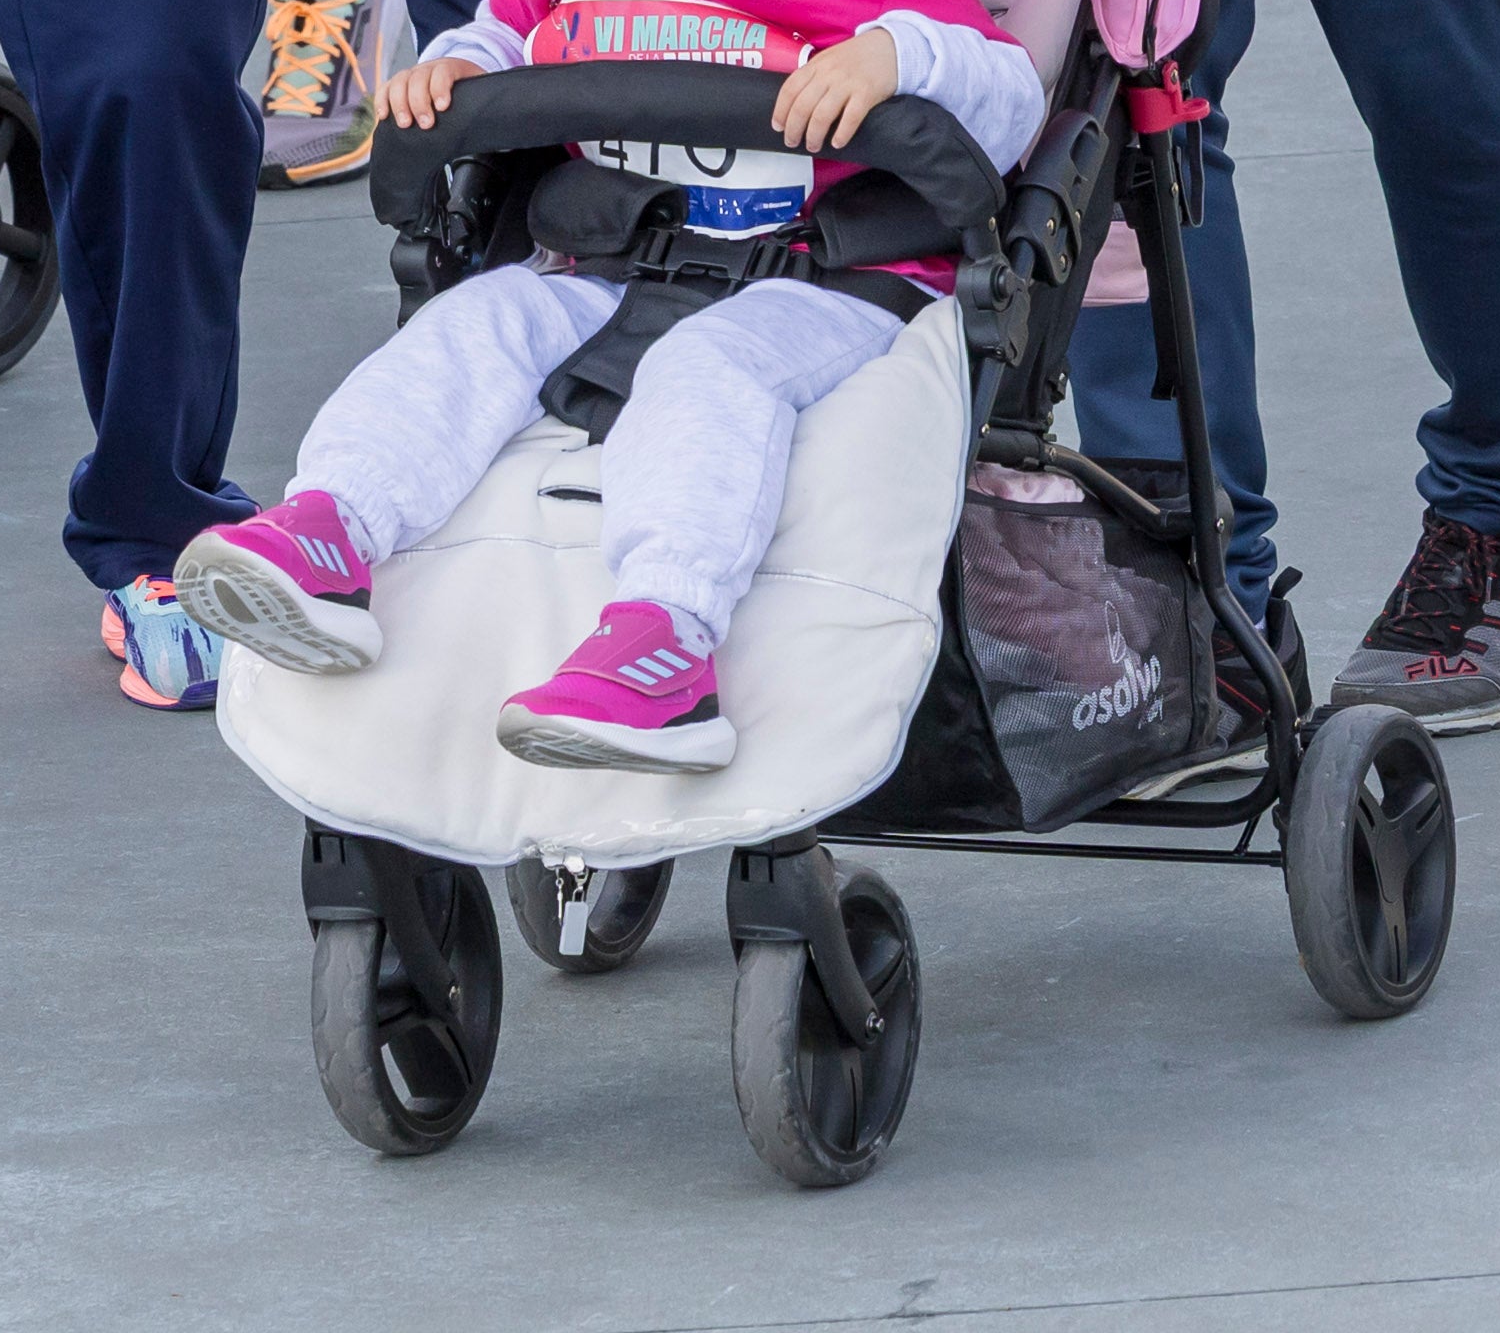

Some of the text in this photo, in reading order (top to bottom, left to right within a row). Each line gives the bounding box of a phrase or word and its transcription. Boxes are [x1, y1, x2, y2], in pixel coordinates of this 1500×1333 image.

[593, 14, 768, 53] VI MARCHA
[1403, 650, 1480, 682] FILA
